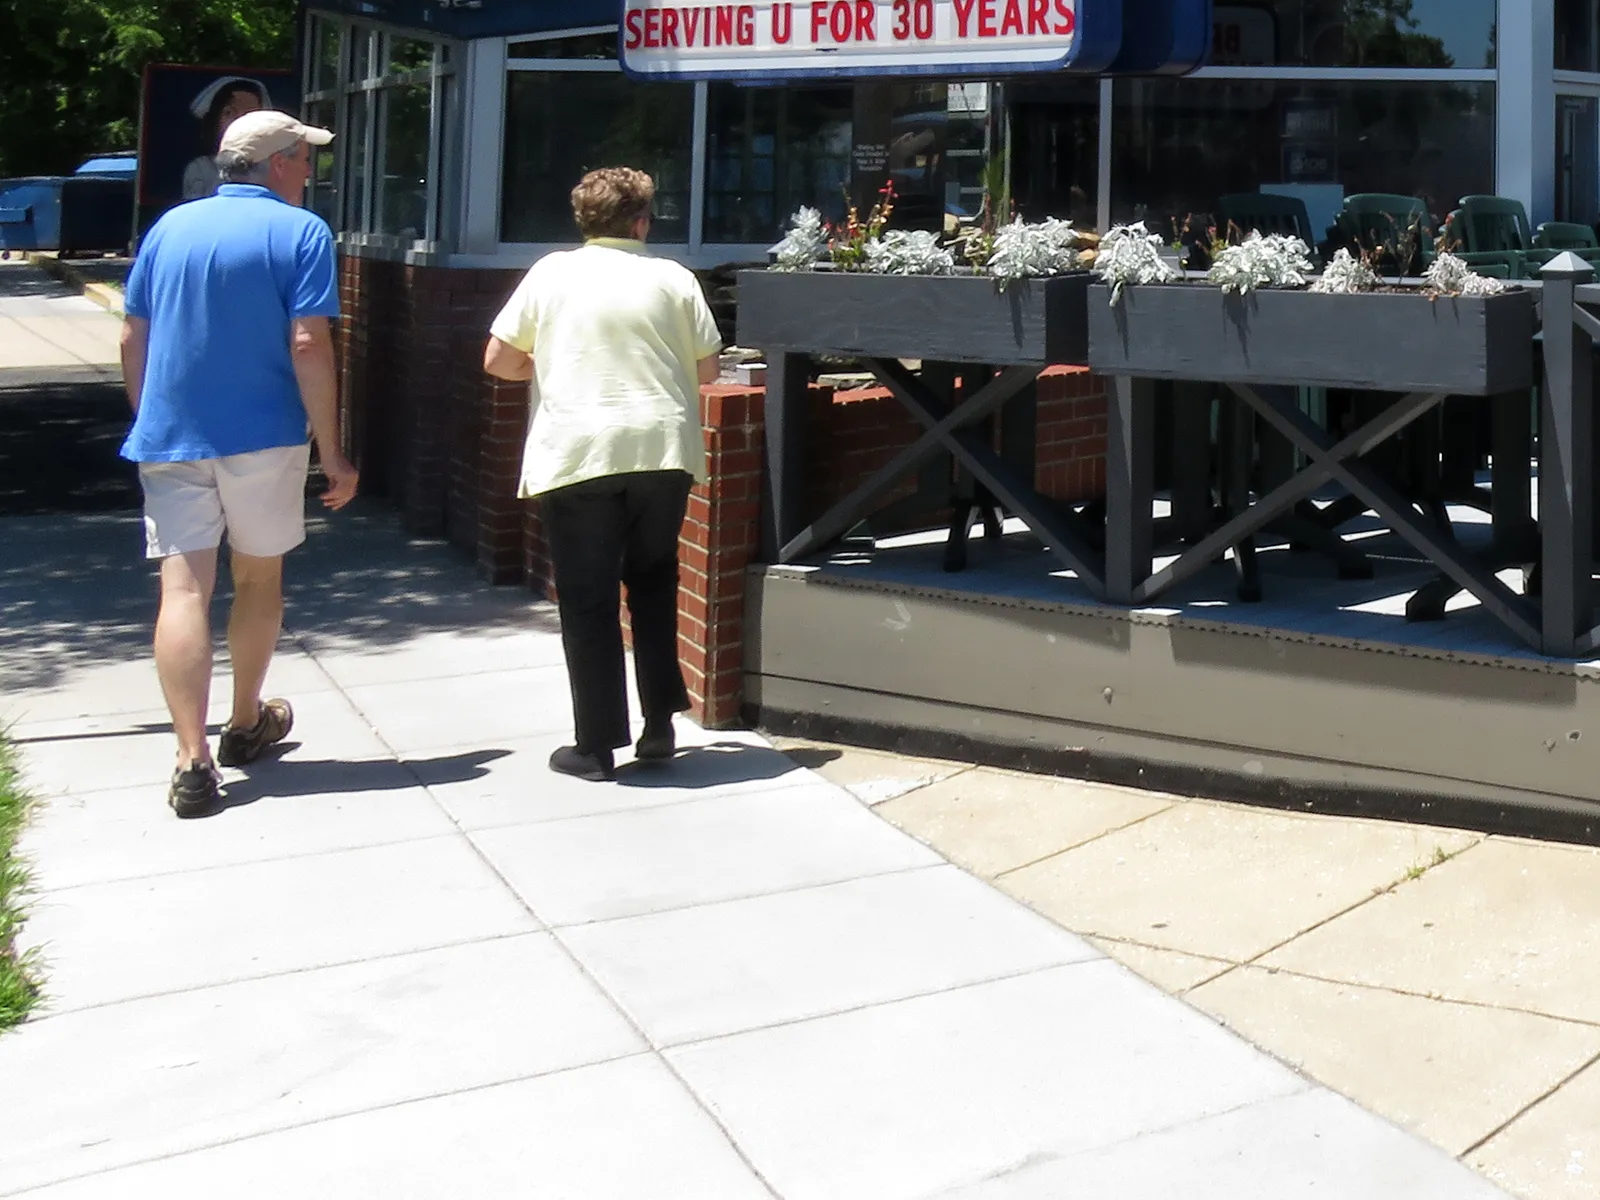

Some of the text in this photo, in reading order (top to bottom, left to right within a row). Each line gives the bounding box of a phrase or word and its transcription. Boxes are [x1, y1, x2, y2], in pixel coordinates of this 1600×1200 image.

[625, 5, 755, 49] SERVING
[771, 3, 793, 43] U
[810, 0, 876, 43] FOR
